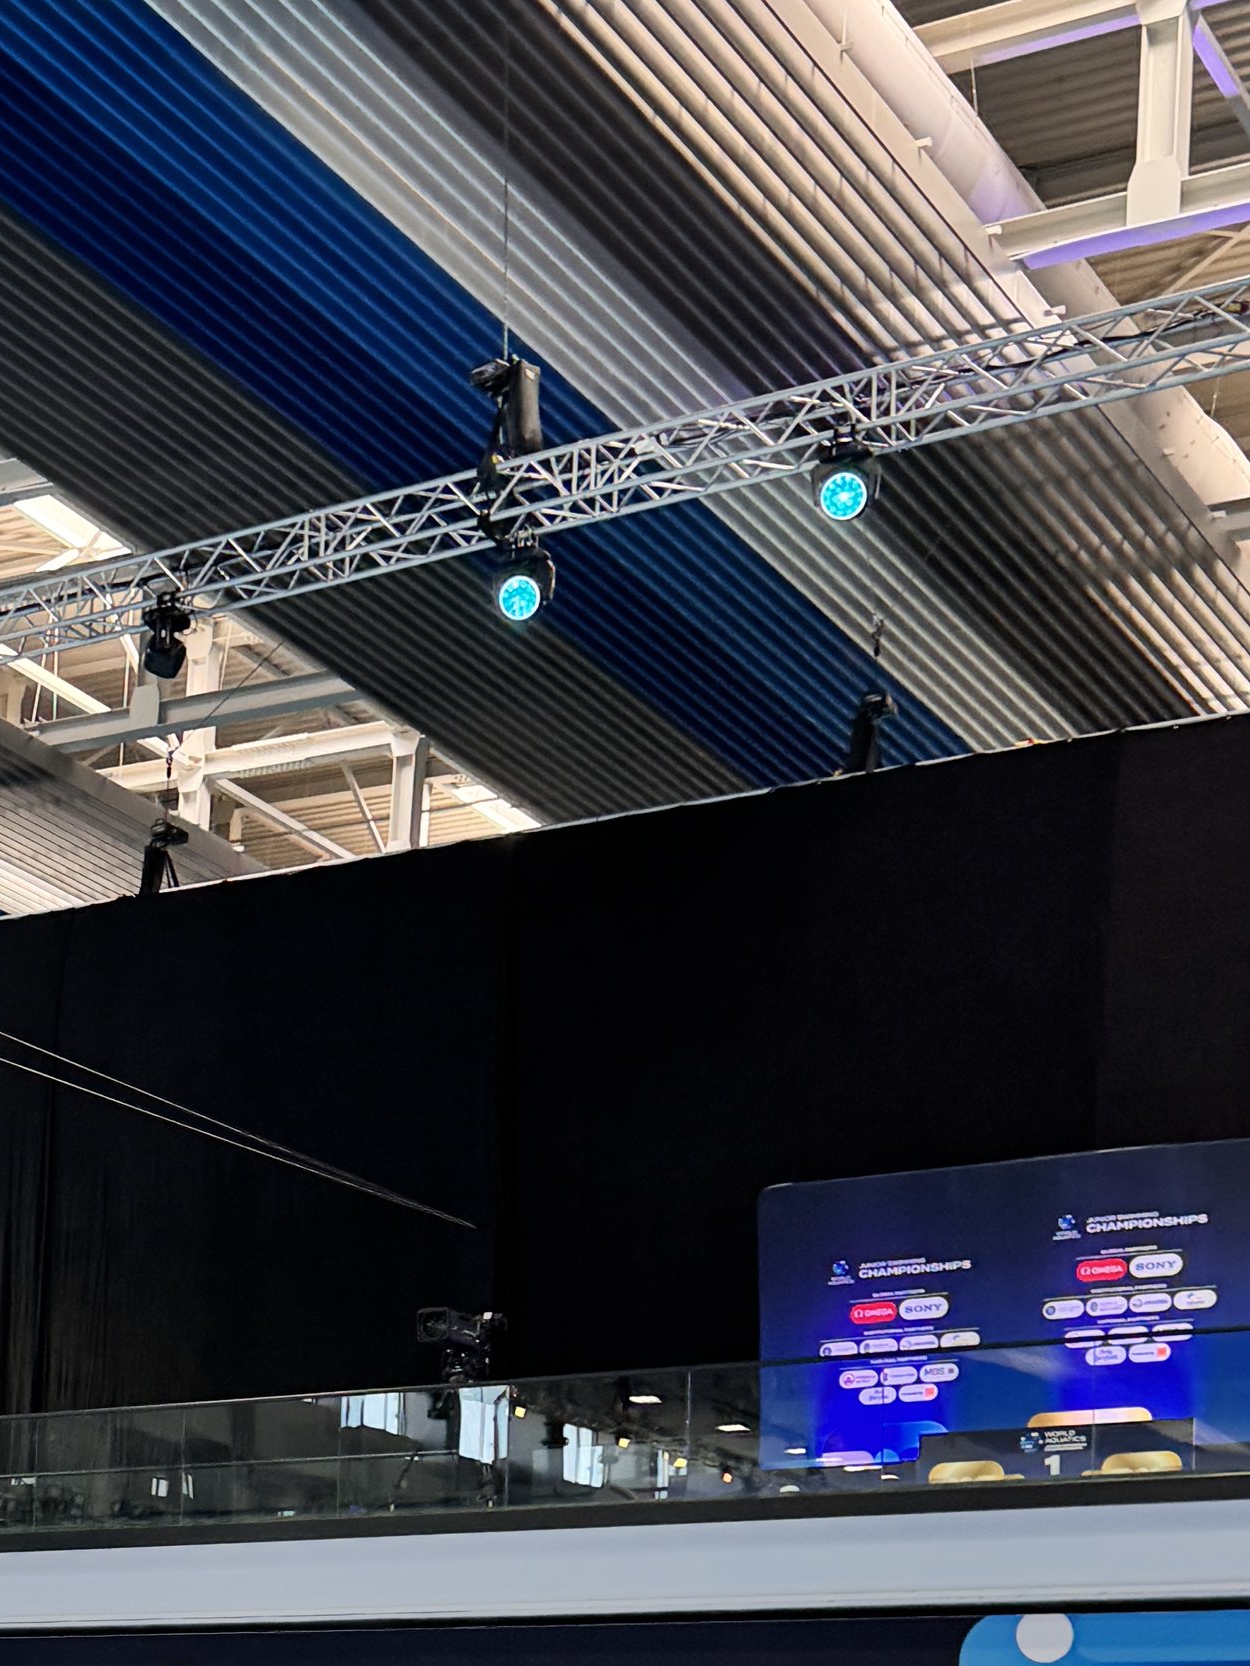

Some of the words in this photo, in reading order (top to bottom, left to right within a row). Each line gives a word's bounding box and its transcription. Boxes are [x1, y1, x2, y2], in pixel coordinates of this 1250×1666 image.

[1086, 1213, 1208, 1234] CHAMPIONSHIPS
[858, 1260, 971, 1279] CHAMPIONSHIPS
[1135, 1260, 1176, 1271] SONY
[904, 1303, 942, 1313] SONY
[1044, 1454, 1060, 1476] 1
